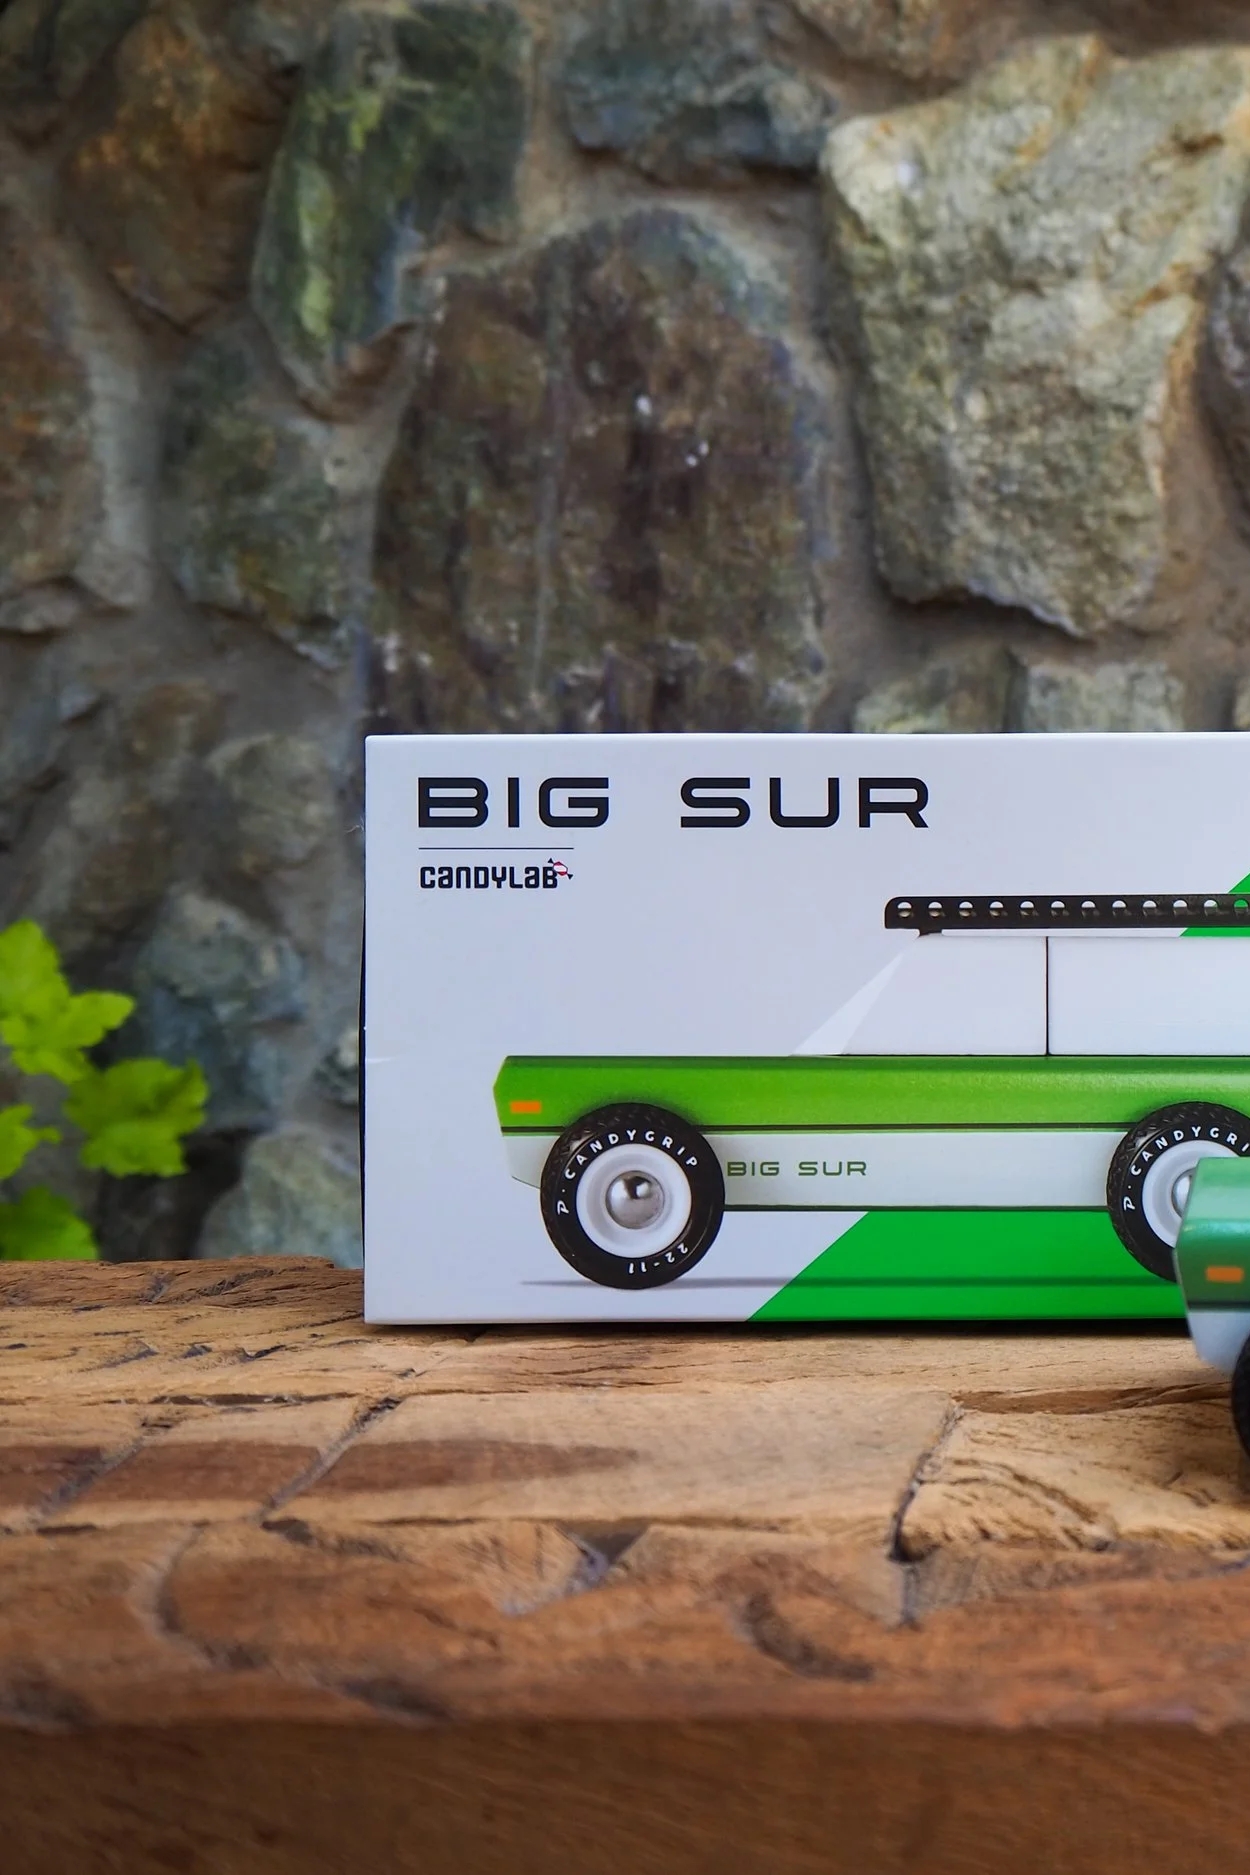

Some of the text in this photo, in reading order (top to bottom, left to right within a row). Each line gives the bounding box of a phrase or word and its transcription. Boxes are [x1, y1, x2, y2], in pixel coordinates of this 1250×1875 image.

[418, 777, 929, 828] BIG SUR
[727, 1161, 867, 1177] BIG SUR
